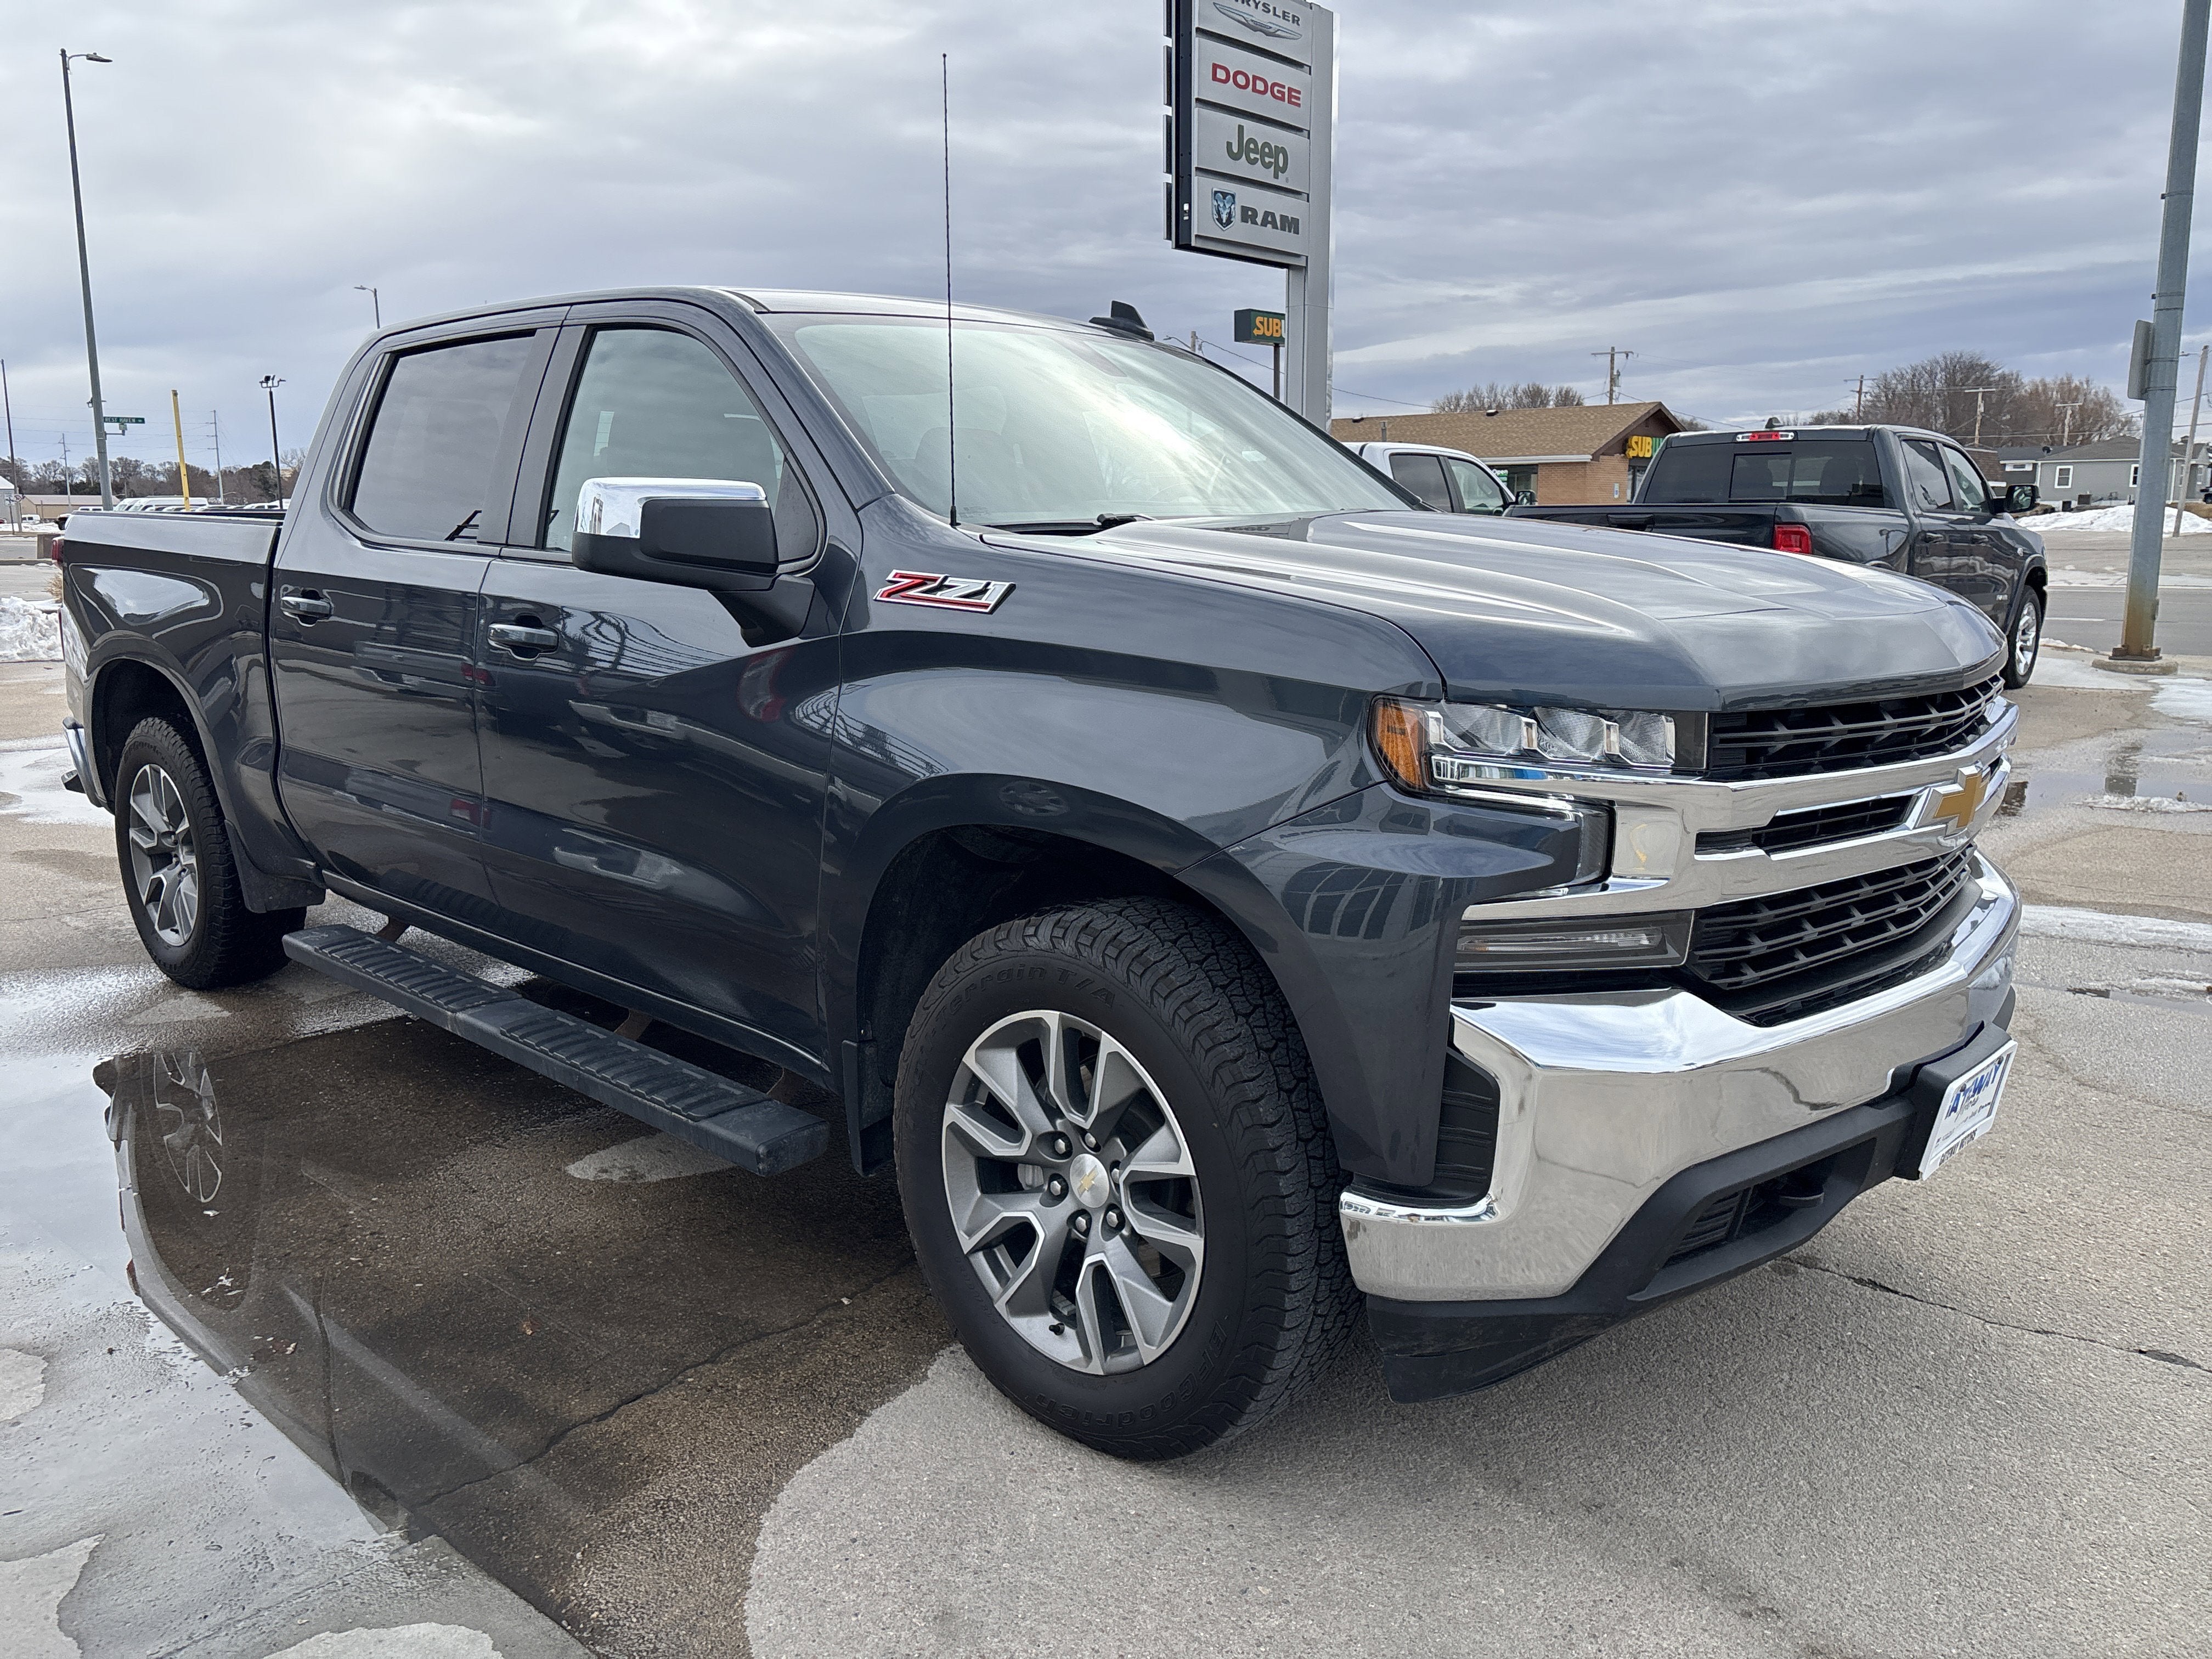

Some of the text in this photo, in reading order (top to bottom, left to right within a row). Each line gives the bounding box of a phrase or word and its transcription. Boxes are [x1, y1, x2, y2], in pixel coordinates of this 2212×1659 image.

[1212, 63, 1301, 108] DODGE
[1226, 125, 1289, 179] Jeep
[1240, 205, 1300, 235] RAM
[872, 569, 1016, 614] Z71
[1036, 1321, 1227, 1429] BFGoodrich
